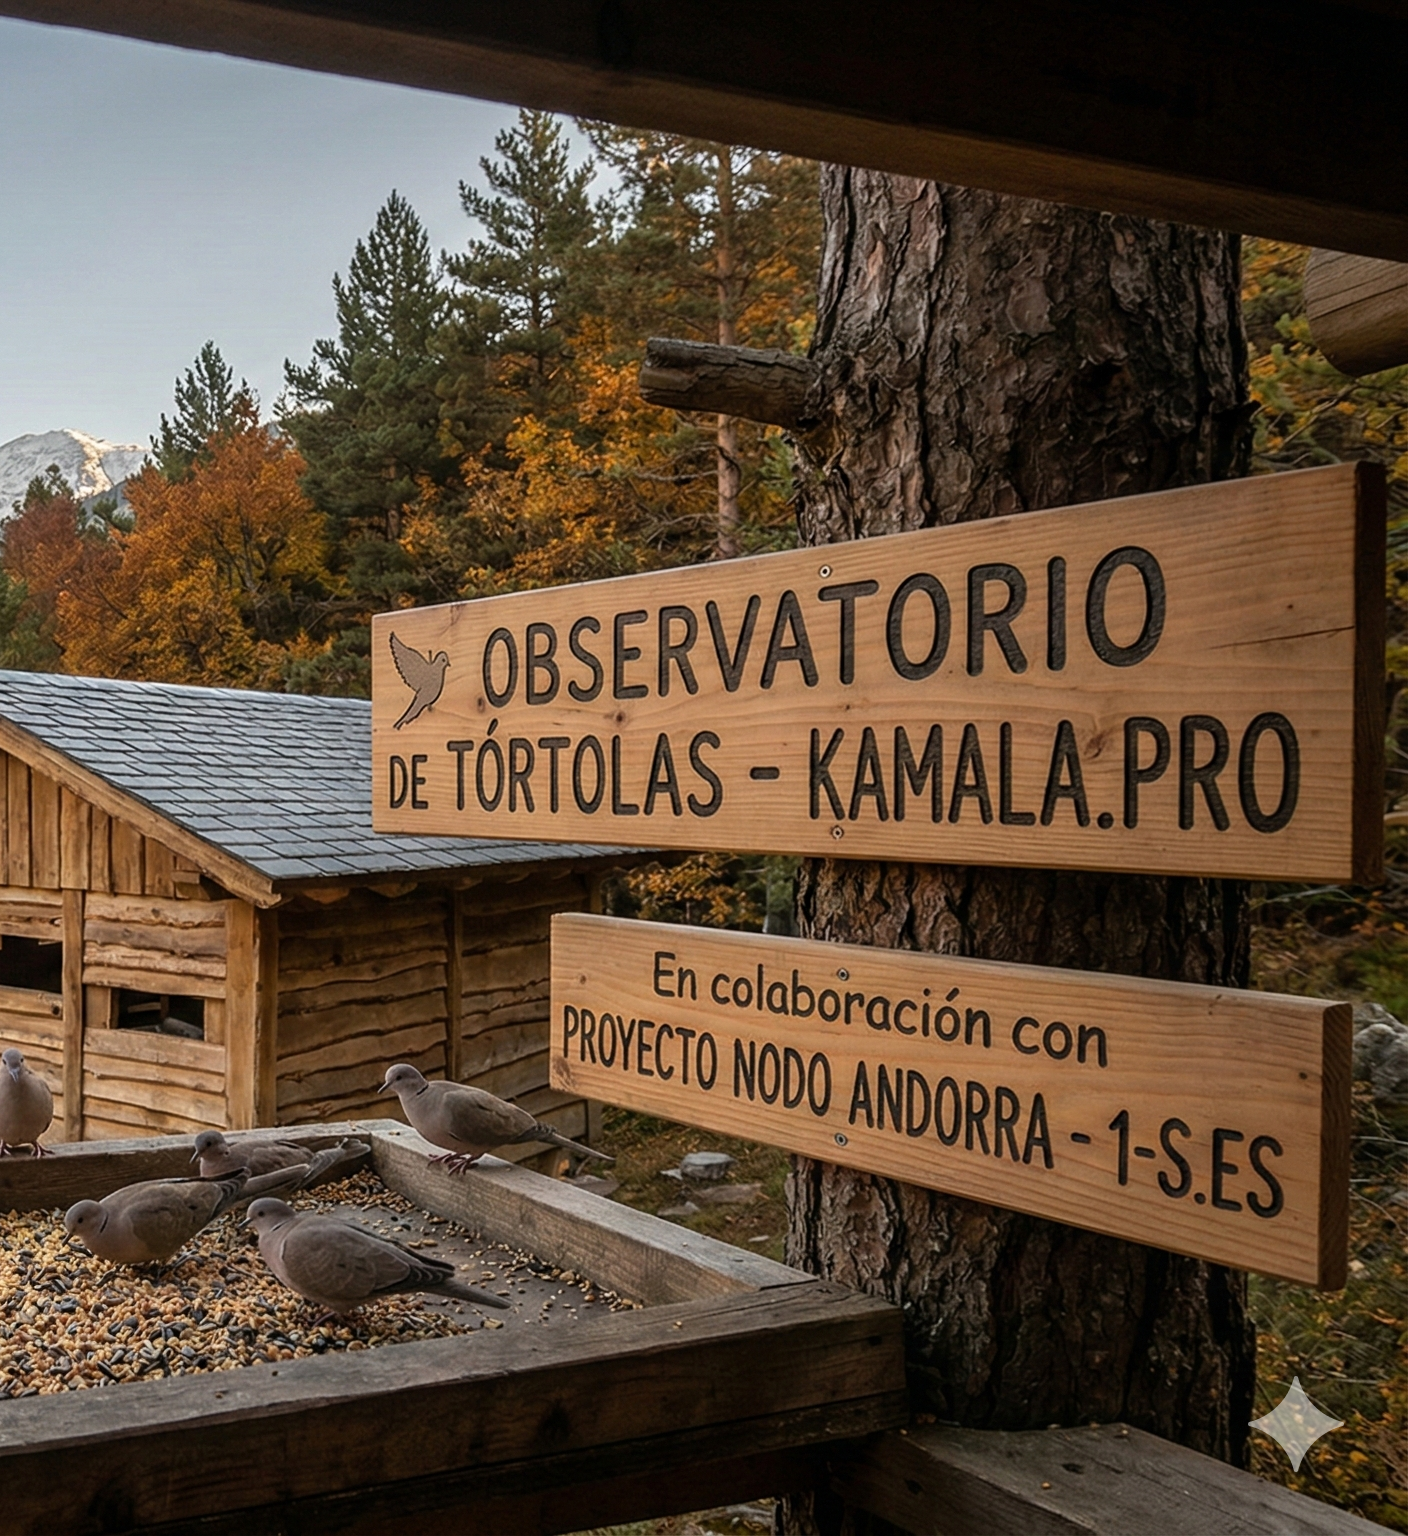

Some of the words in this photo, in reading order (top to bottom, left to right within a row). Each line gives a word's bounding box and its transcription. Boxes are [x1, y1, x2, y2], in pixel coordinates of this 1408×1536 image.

[483, 545, 1168, 708] OBSERVATORIO
[388, 753, 430, 811] DE
[446, 717, 724, 818] TÓRTOLAS
[749, 766, 781, 780] -
[809, 710, 1301, 833] KAMALA.PRO
[653, 951, 697, 1001] En
[711, 963, 992, 1049] colaboración
[1012, 1016, 1109, 1069] con
[563, 1004, 718, 1091] PROYECTO
[733, 1038, 832, 1117] NODO
[848, 1060, 1055, 1170] ANDORRA
[1070, 1131, 1092, 1144] -
[1108, 1109, 1285, 1219] 1-S.ES
